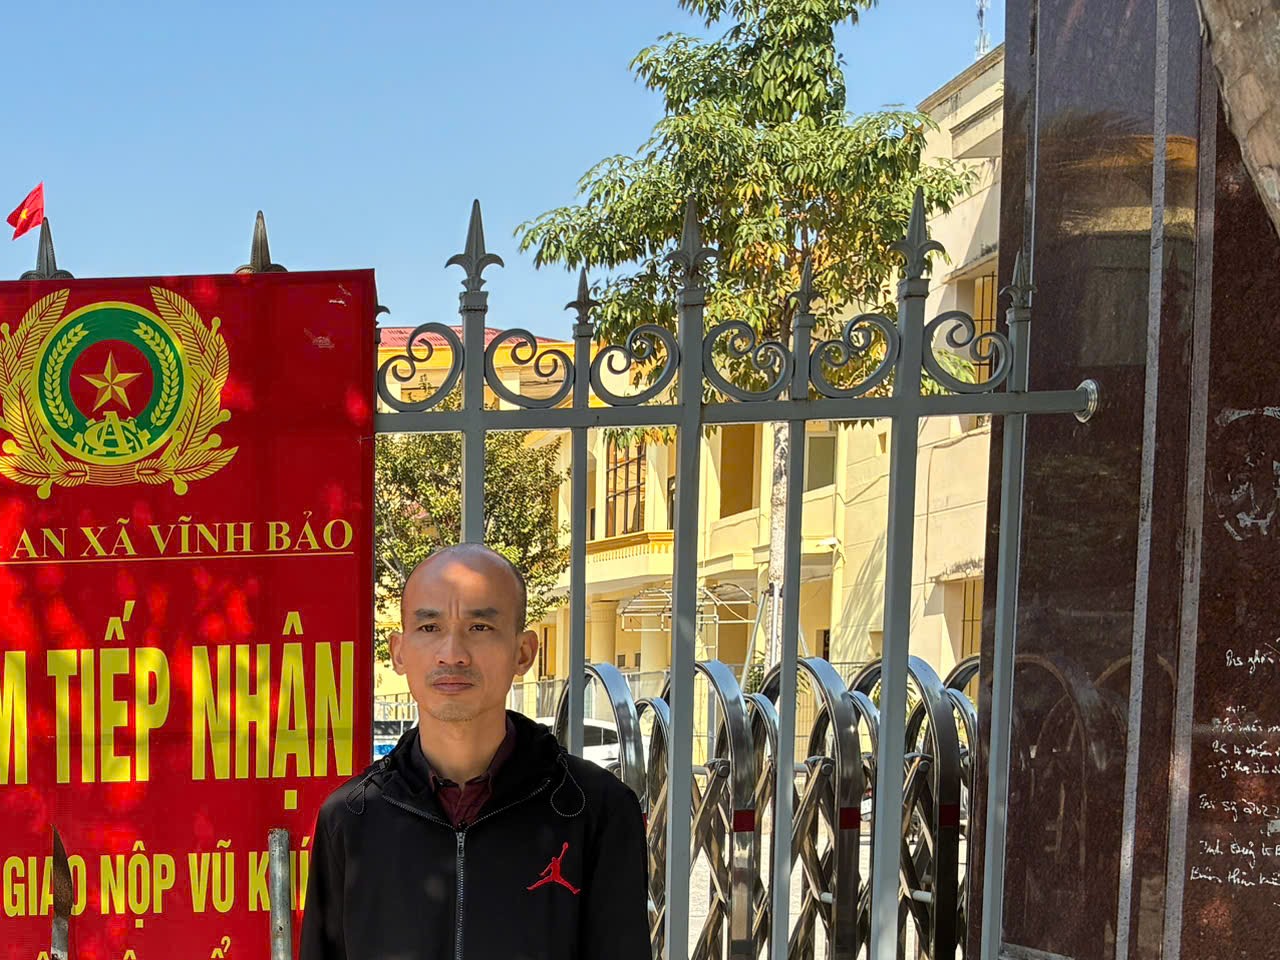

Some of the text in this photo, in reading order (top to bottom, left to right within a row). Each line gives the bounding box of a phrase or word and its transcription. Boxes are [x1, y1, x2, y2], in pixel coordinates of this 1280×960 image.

[12, 526, 67, 560] AN
[81, 517, 138, 558] XÃ
[150, 516, 253, 553] VĨNH
[267, 510, 354, 552] BẢO
[46, 600, 170, 783] TIẾP
[191, 611, 353, 809] NHẬN
[100, 840, 175, 928] NỘP
[187, 840, 234, 912] VŨ
